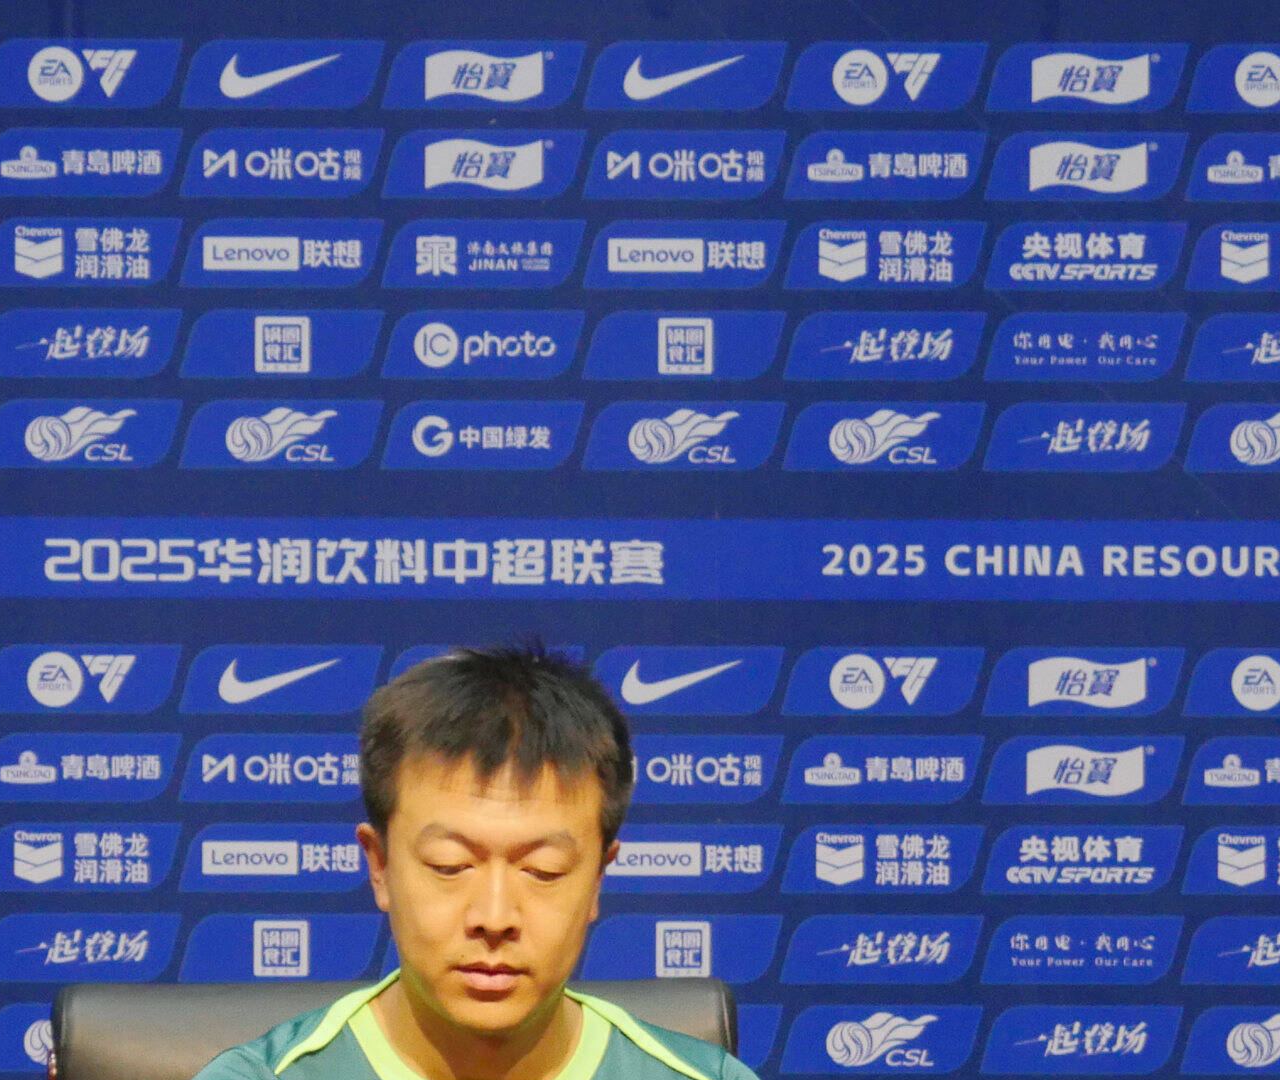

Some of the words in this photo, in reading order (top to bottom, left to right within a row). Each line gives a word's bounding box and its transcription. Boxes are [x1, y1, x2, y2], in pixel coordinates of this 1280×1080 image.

[843, 64, 873, 80] EA
[1246, 66, 1276, 82] EA
[61, 149, 161, 175] 青岛啤酒
[868, 152, 968, 178] 青岛啤酒
[75, 228, 150, 253] 雪佛龙
[817, 230, 864, 240] Chevron
[878, 232, 954, 256] 雪佛龙
[1022, 233, 1146, 259] 央视体育
[212, 246, 290, 262] Lenovo
[302, 240, 361, 268] 联想
[467, 258, 518, 271] JINAN
[617, 246, 694, 264] Lenovo
[708, 241, 766, 268] 联想
[75, 255, 150, 280] 润滑油
[878, 258, 954, 282] 润滑油
[1060, 264, 1158, 280] SPORTS
[820, 328, 954, 367] 一起登场
[458, 426, 550, 449] 中国绿发
[1016, 421, 1151, 454] 一起登场
[86, 444, 132, 462] CSL
[688, 446, 735, 464] CSL
[888, 447, 935, 466] CSL
[43, 537, 664, 585] 2025华润饮料中超联赛
[822, 544, 927, 577] 2025
[944, 544, 1084, 577] CHINA
[840, 668, 870, 684] EA
[865, 756, 965, 782] 青岛啤酒
[814, 832, 862, 844] Chevron
[875, 834, 950, 859] 雪佛龙
[1019, 836, 1142, 862] 央视体育
[614, 850, 692, 868] Lenovo
[704, 845, 763, 872] 联想
[875, 861, 950, 886] 润滑油
[1057, 866, 1154, 884] SPORTS
[1013, 1024, 1148, 1057] 一起登场
[886, 1049, 933, 1068] CSL
